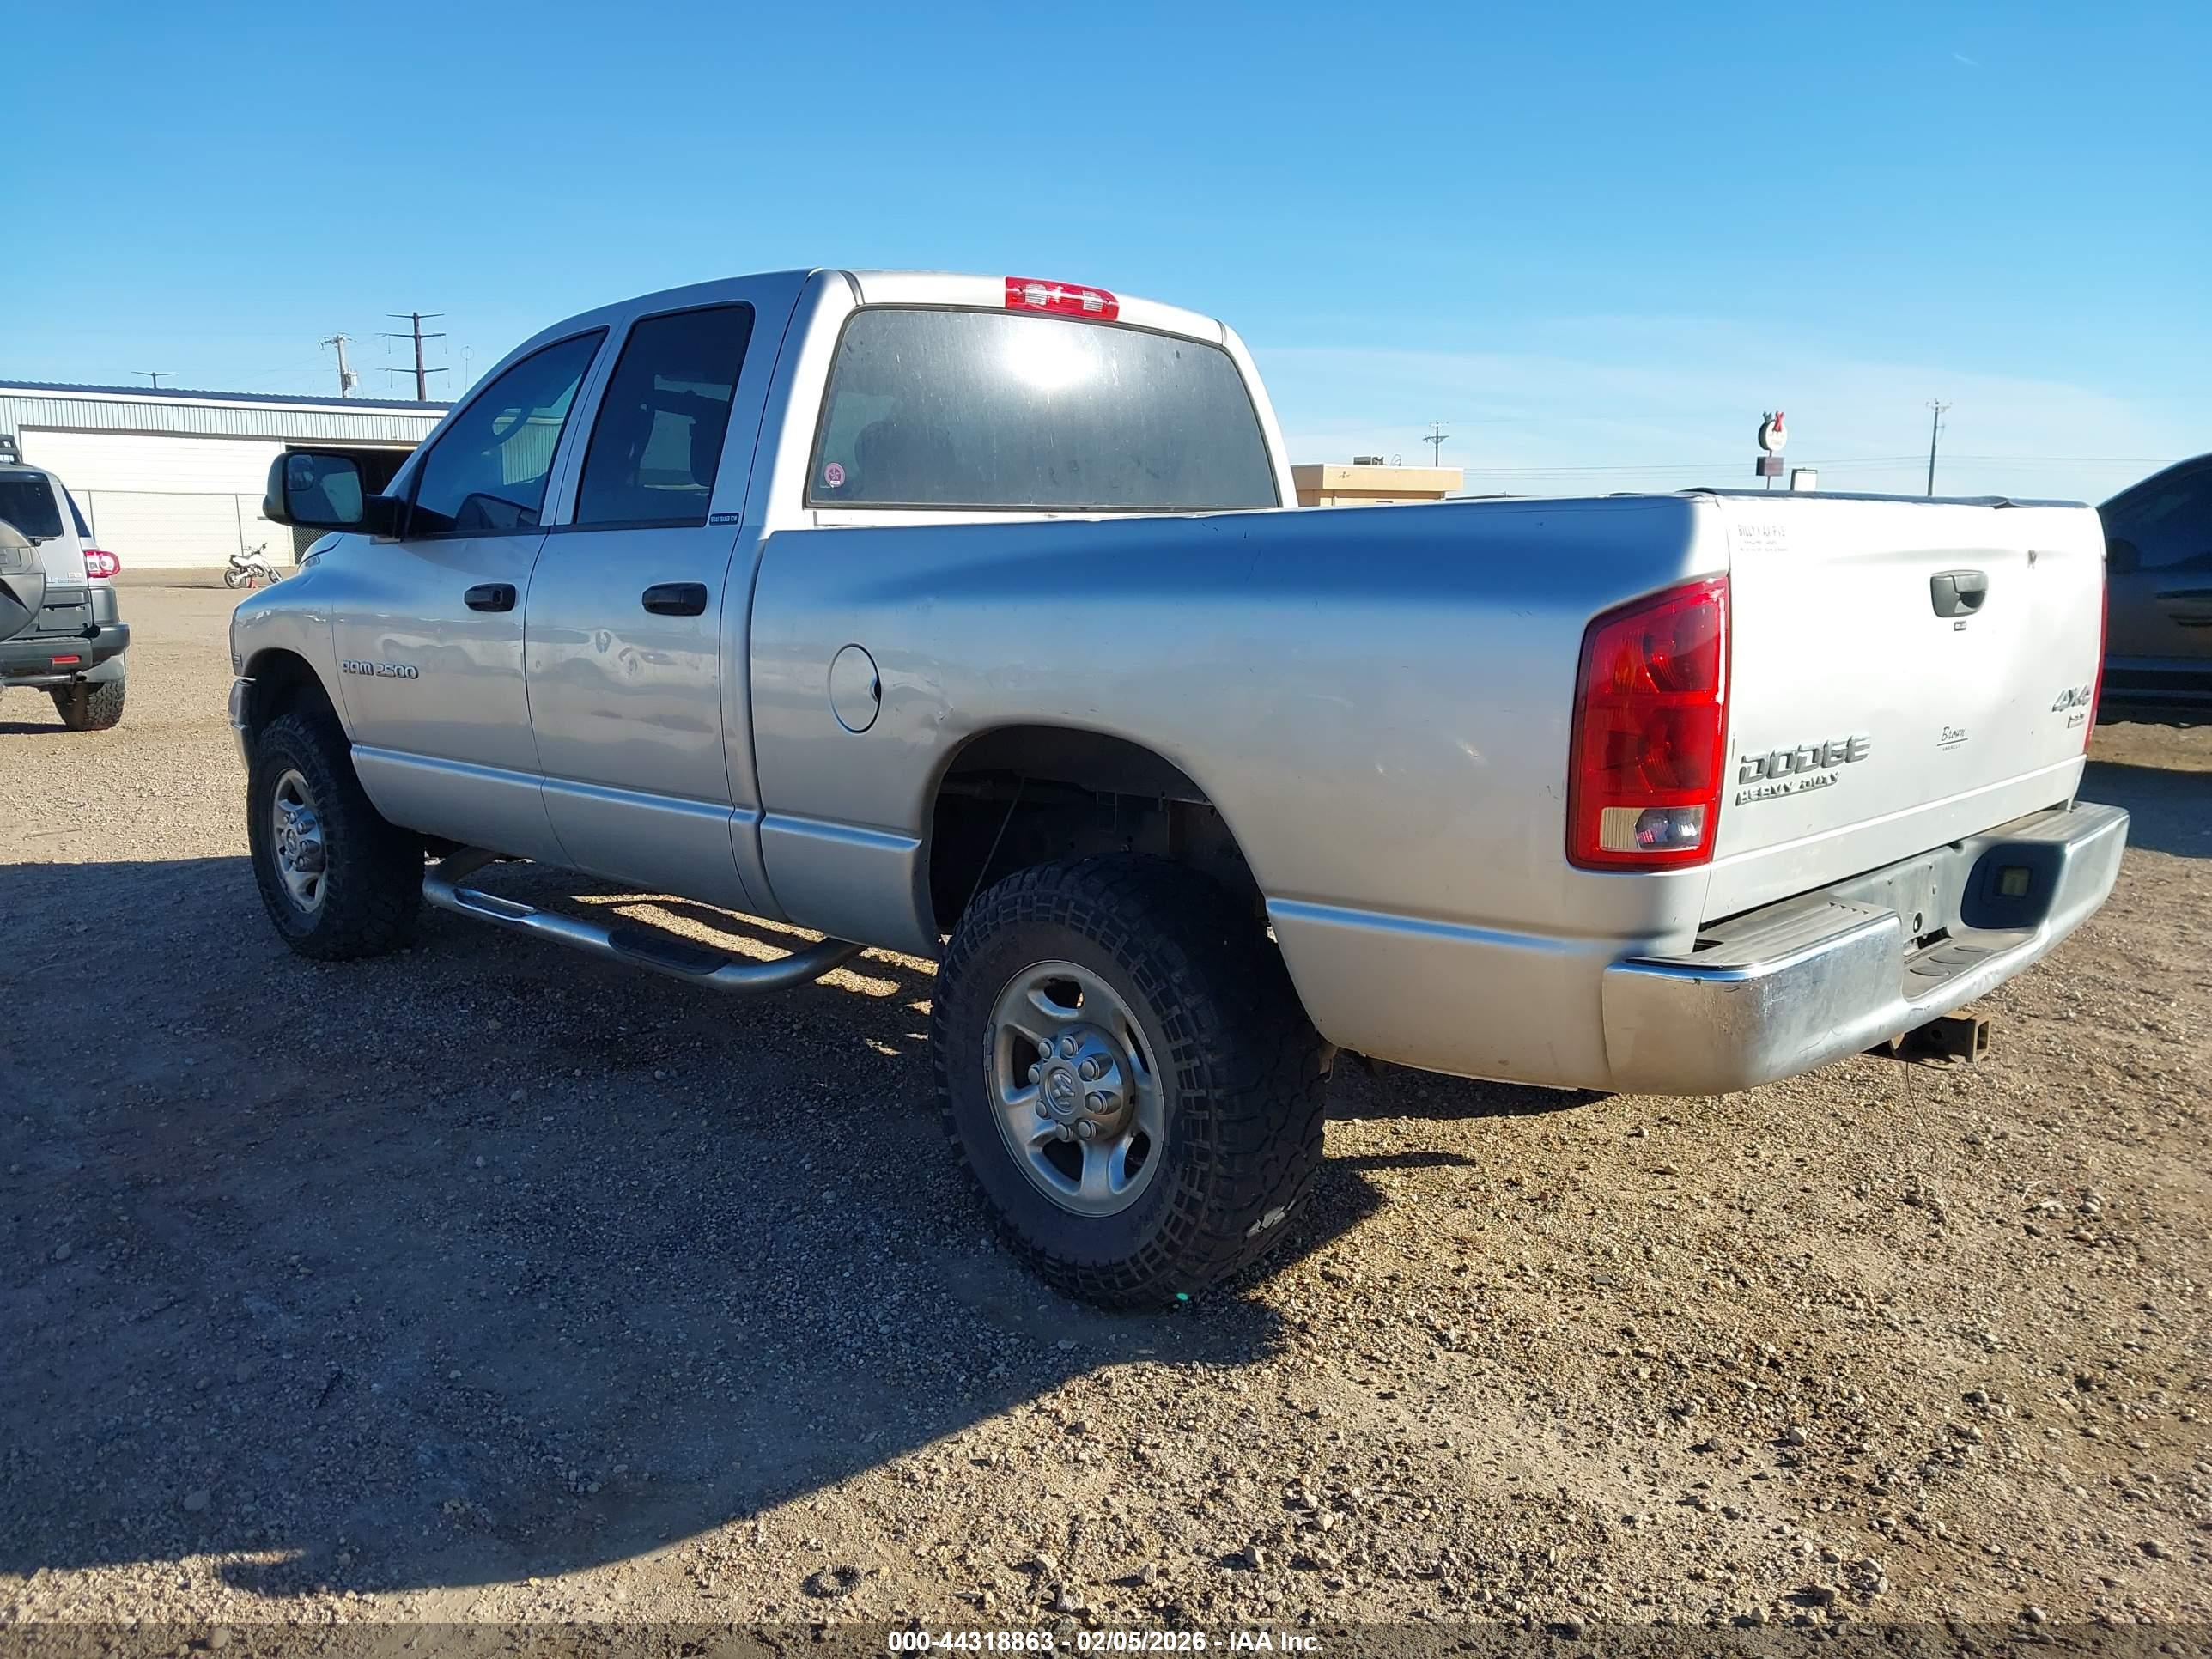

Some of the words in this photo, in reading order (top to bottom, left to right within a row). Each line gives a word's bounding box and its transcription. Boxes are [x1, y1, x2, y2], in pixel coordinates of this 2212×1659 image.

[343, 660, 374, 676] RAM
[376, 663, 419, 679] 2500
[1739, 735, 1872, 785] DODGE
[1735, 781, 1793, 807] HEAVY
[1798, 771, 1840, 790] DUTY
